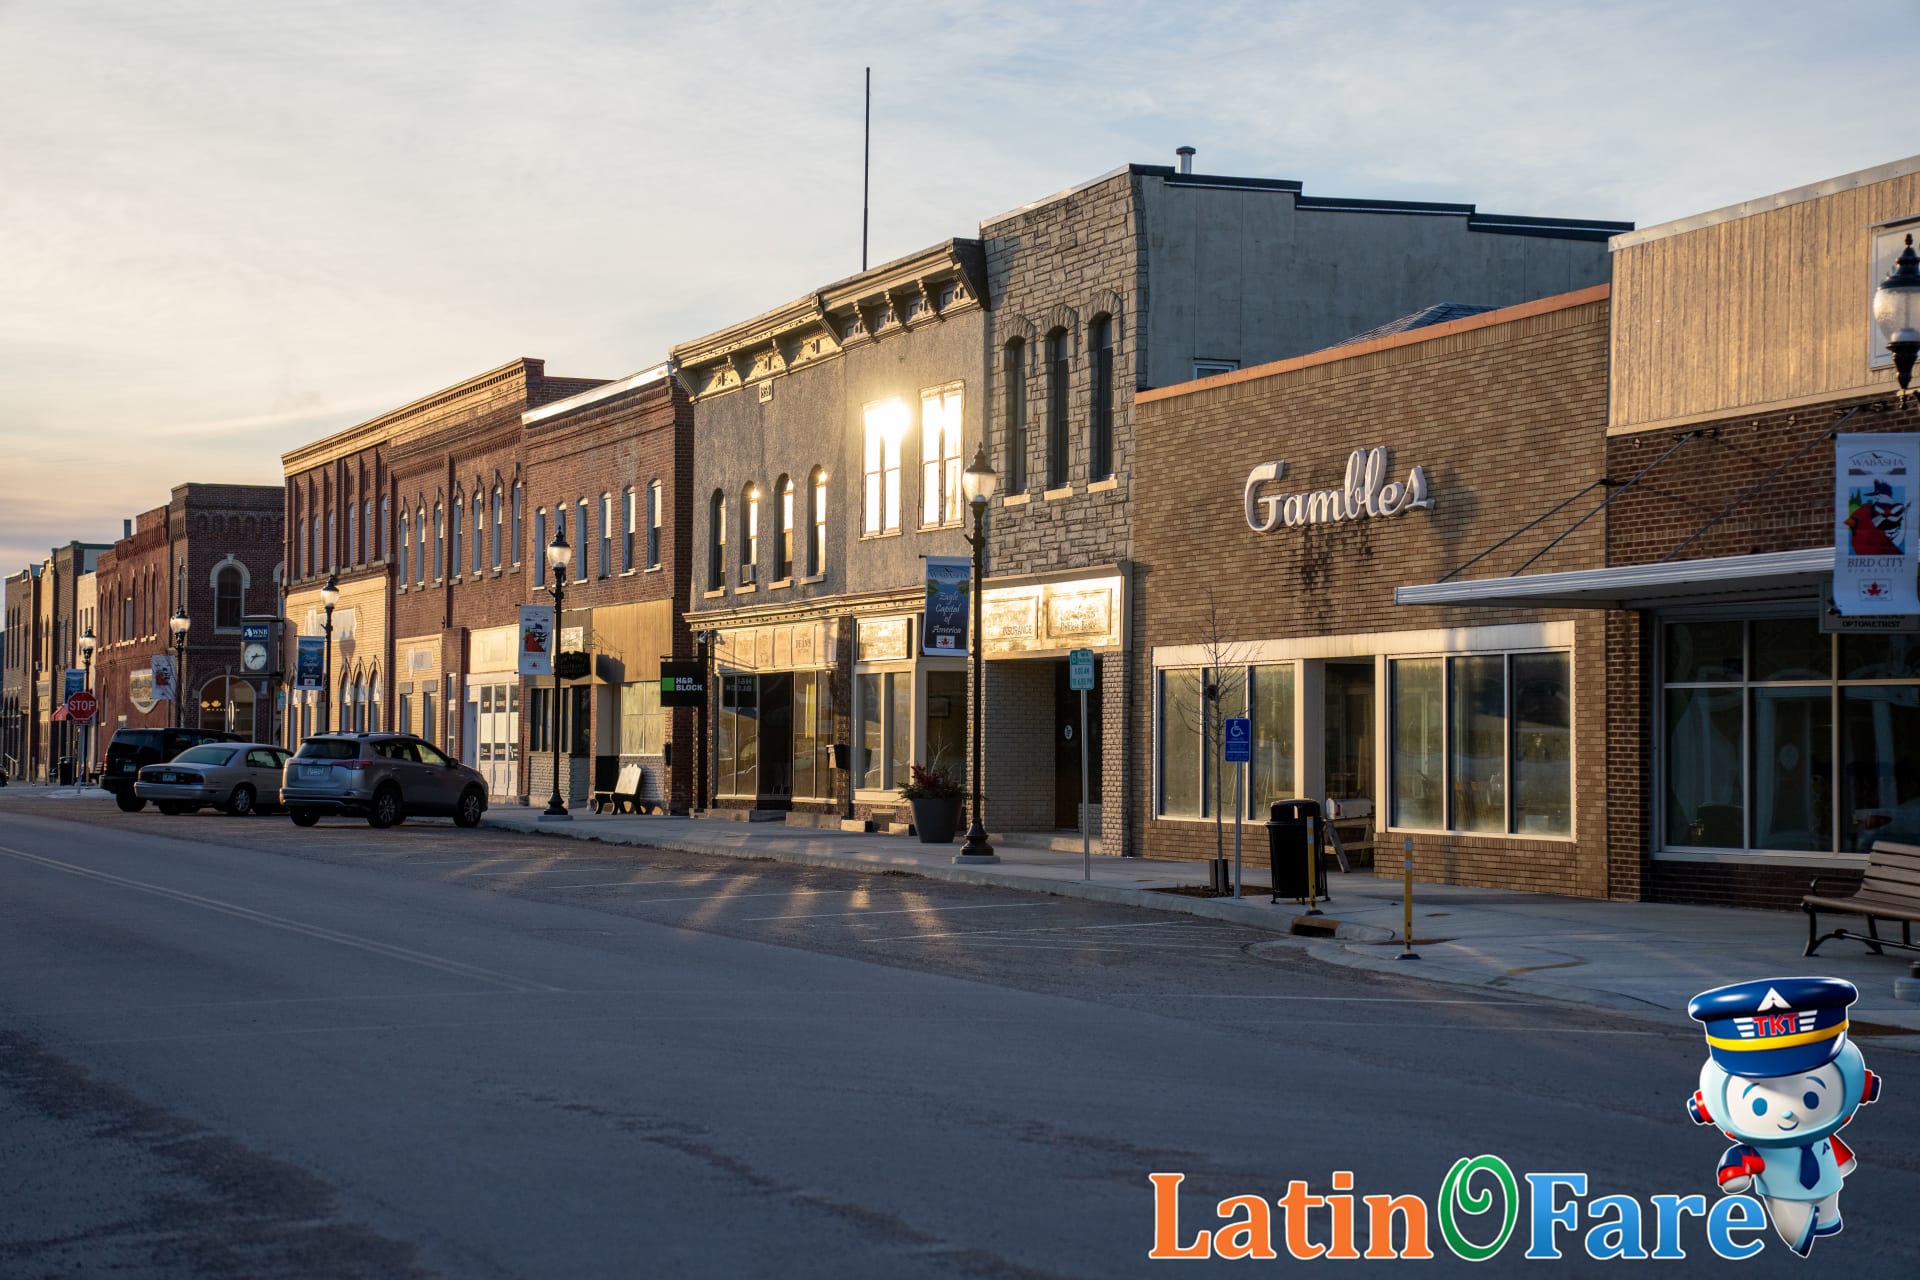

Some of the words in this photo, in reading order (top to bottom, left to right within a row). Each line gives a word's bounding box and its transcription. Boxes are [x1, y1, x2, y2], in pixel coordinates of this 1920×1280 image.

[1852, 459, 1905, 467] WABASHA
[1244, 446, 1436, 533] Gambles
[1848, 558, 1875, 568] BIRD
[1878, 557, 1905, 567] CITY
[939, 591, 959, 605] Eagle
[936, 603, 962, 617] Capital
[943, 613, 953, 625] of
[932, 625, 962, 634] America
[69, 700, 96, 711] STOP
